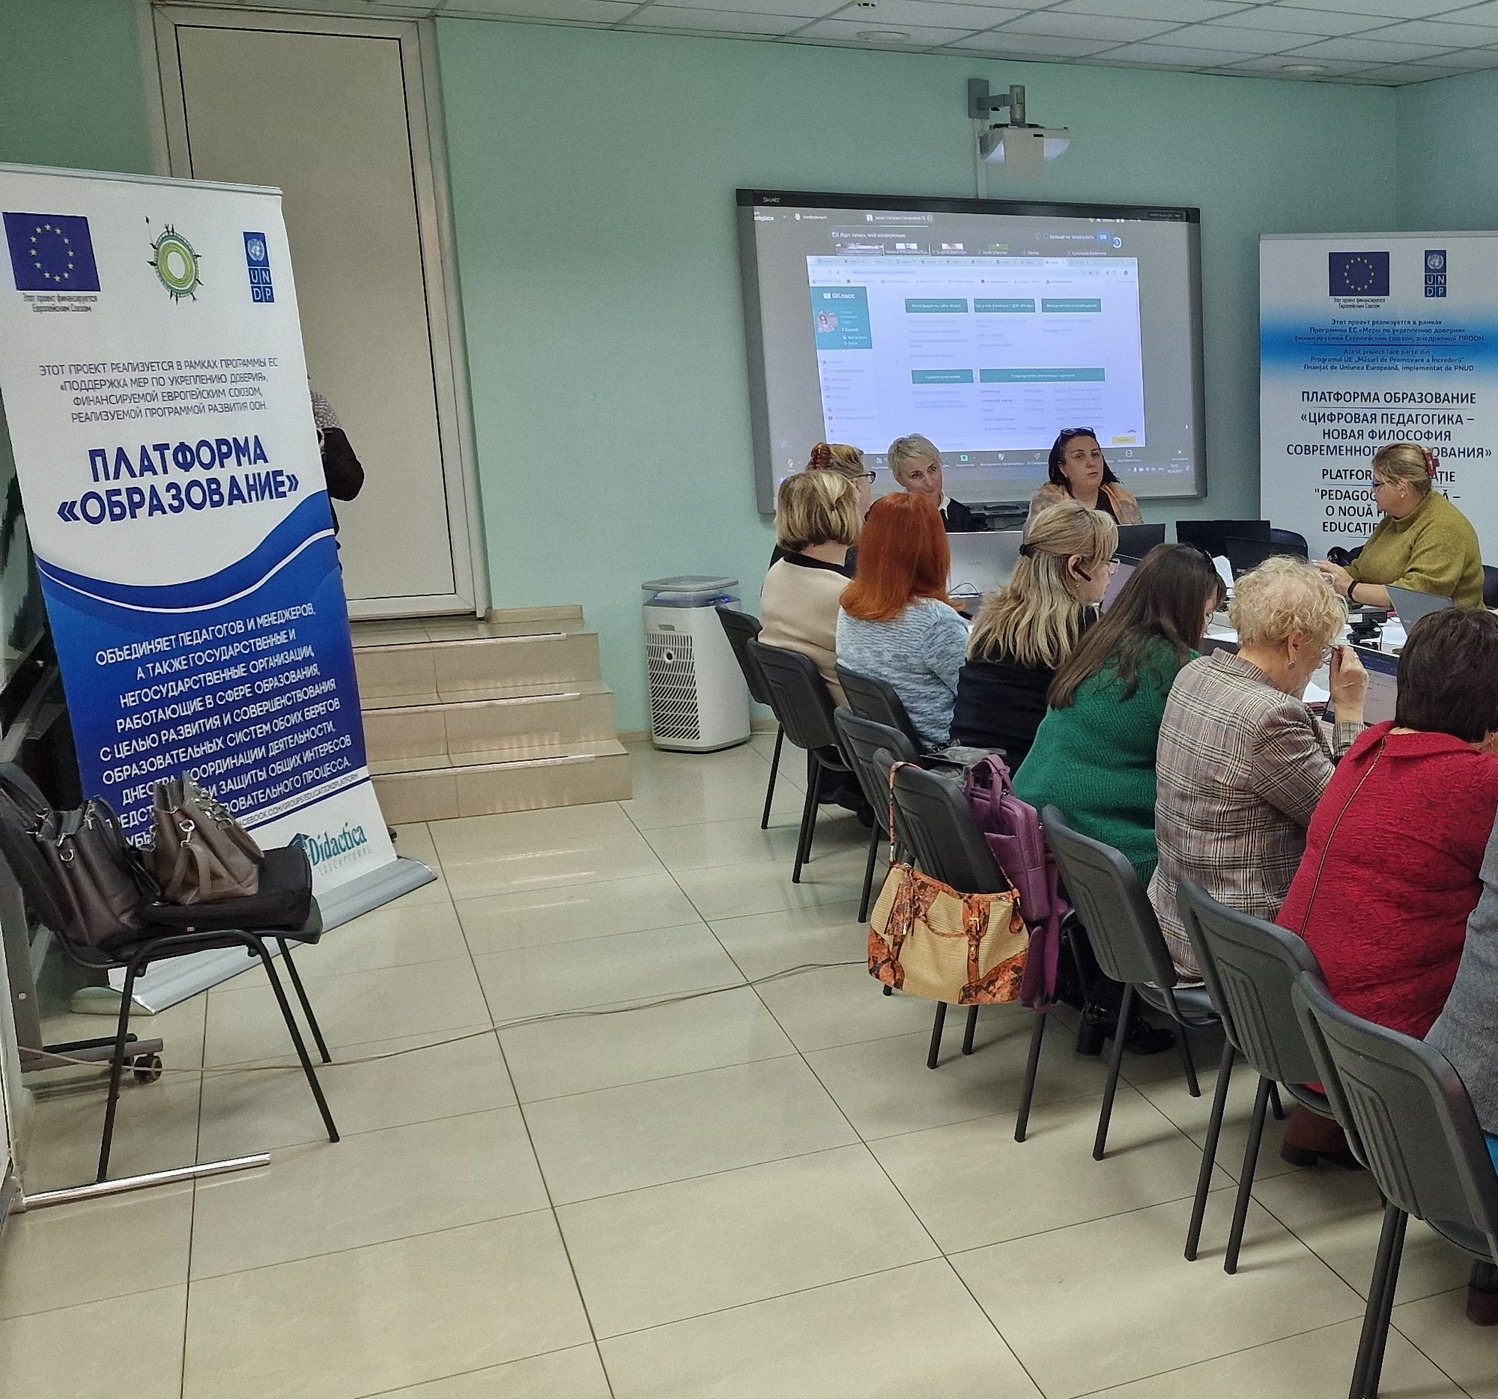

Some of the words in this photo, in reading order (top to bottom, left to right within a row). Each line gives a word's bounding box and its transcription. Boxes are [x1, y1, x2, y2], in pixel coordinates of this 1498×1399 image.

[250, 269, 270, 283] UN
[1426, 274, 1445, 284] UN
[252, 287, 272, 300] DP
[1426, 287, 1444, 296] DP
[1371, 319, 1411, 327] реализуется
[1391, 327, 1432, 335] укреплению
[39, 364, 65, 376] ЭТОТ
[68, 362, 107, 375] ПРОЕКТ
[111, 360, 174, 373] РЕАЛИЗУЕТСЯ
[176, 360, 183, 371] В
[184, 359, 218, 371] РАМКАХ
[220, 357, 267, 369] ПРОГРАММЫ
[268, 357, 279, 367] ЕС
[1401, 365, 1443, 373] implementat
[60, 378, 128, 392] «ПОДДЕРЖКА
[130, 377, 149, 388] МЕР
[151, 376, 166, 387] ПО
[168, 373, 228, 387] УКРЕПЛЕНИЮ
[230, 371, 269, 384] ДОВЕРИЯ»,
[73, 389, 159, 407] ФИНАНСИРУЕМОЙ
[161, 386, 227, 402] ЕВРОПЕЙСКИМ
[228, 386, 263, 398] СОЮЗОМ,
[1301, 391, 1381, 404] ПЛАТФОРМА
[1383, 392, 1477, 404] ОБРАЗОВАНИЕ
[71, 406, 143, 423] РЕАЛИЗУЕМОЙ
[145, 402, 206, 418] ПРОГРАММОЙ
[208, 402, 249, 414] РАЗВИТИЯ
[249, 400, 268, 411] ООН.
[1300, 412, 1377, 425] «ЦИФРОВАЯ
[1380, 413, 1464, 427] ПЕДАГОГИКА
[1322, 428, 1364, 440] НОВАЯ
[1367, 429, 1451, 441] ФИЛОСОФИЯ
[88, 434, 269, 482] ПЛАТФОРМА
[1322, 468, 1373, 481] PLATFOR
[56, 469, 300, 525] «ОБРАЗОВАНИЕ»
[1325, 505, 1335, 517] O
[1338, 503, 1373, 517] NOUĂ
[95, 634, 177, 666] ОБЪЕДИНЯЕТ
[178, 619, 245, 648] ПЕДАГОГОВ
[246, 617, 257, 631] И
[256, 602, 317, 629] МЕНЕДЖЕРОВ,
[135, 666, 146, 681] А
[146, 655, 188, 679] ТАКЖЕ
[189, 630, 289, 666] ГОСУДАРСТВЕННЫЕ
[288, 628, 297, 641] И
[119, 663, 248, 709] НЕГОСУДАРСТВЕННЫЕ
[249, 644, 316, 674] ОРГАНИЗАЦИИ,
[116, 697, 204, 734] РАБОТАЮЩИЕ
[205, 693, 214, 708] В
[215, 683, 252, 706] СФЕРЕ
[253, 663, 321, 695] ОБРАЗОВАНИЯ,
[99, 747, 112, 762] С
[113, 732, 159, 760] ЦЕЛЬЮ
[160, 715, 221, 745] РАЗВИТИЯ
[222, 711, 233, 727] И
[233, 678, 337, 722] СОВЕРШЕНСТВОВАНИЯ
[102, 737, 225, 785] ОБРАЗОВАТЕЛЬНЫХ
[226, 722, 272, 747] СИСТЕМ
[271, 710, 304, 734] ОБОИХ
[304, 697, 341, 720] БЕРЕГОВ
[187, 746, 267, 782] ООРДИНАЦИИ
[268, 719, 336, 757] ДЕЯТЕЛЬНОСТИ,
[219, 767, 268, 799] ЗАЩИТЫ
[268, 754, 303, 778] ОБЩИХ
[302, 733, 352, 765] ИНТЕРЕСОВ
[302, 755, 352, 782] ПРОЦЕССА.
[308, 821, 368, 867] Didactica
